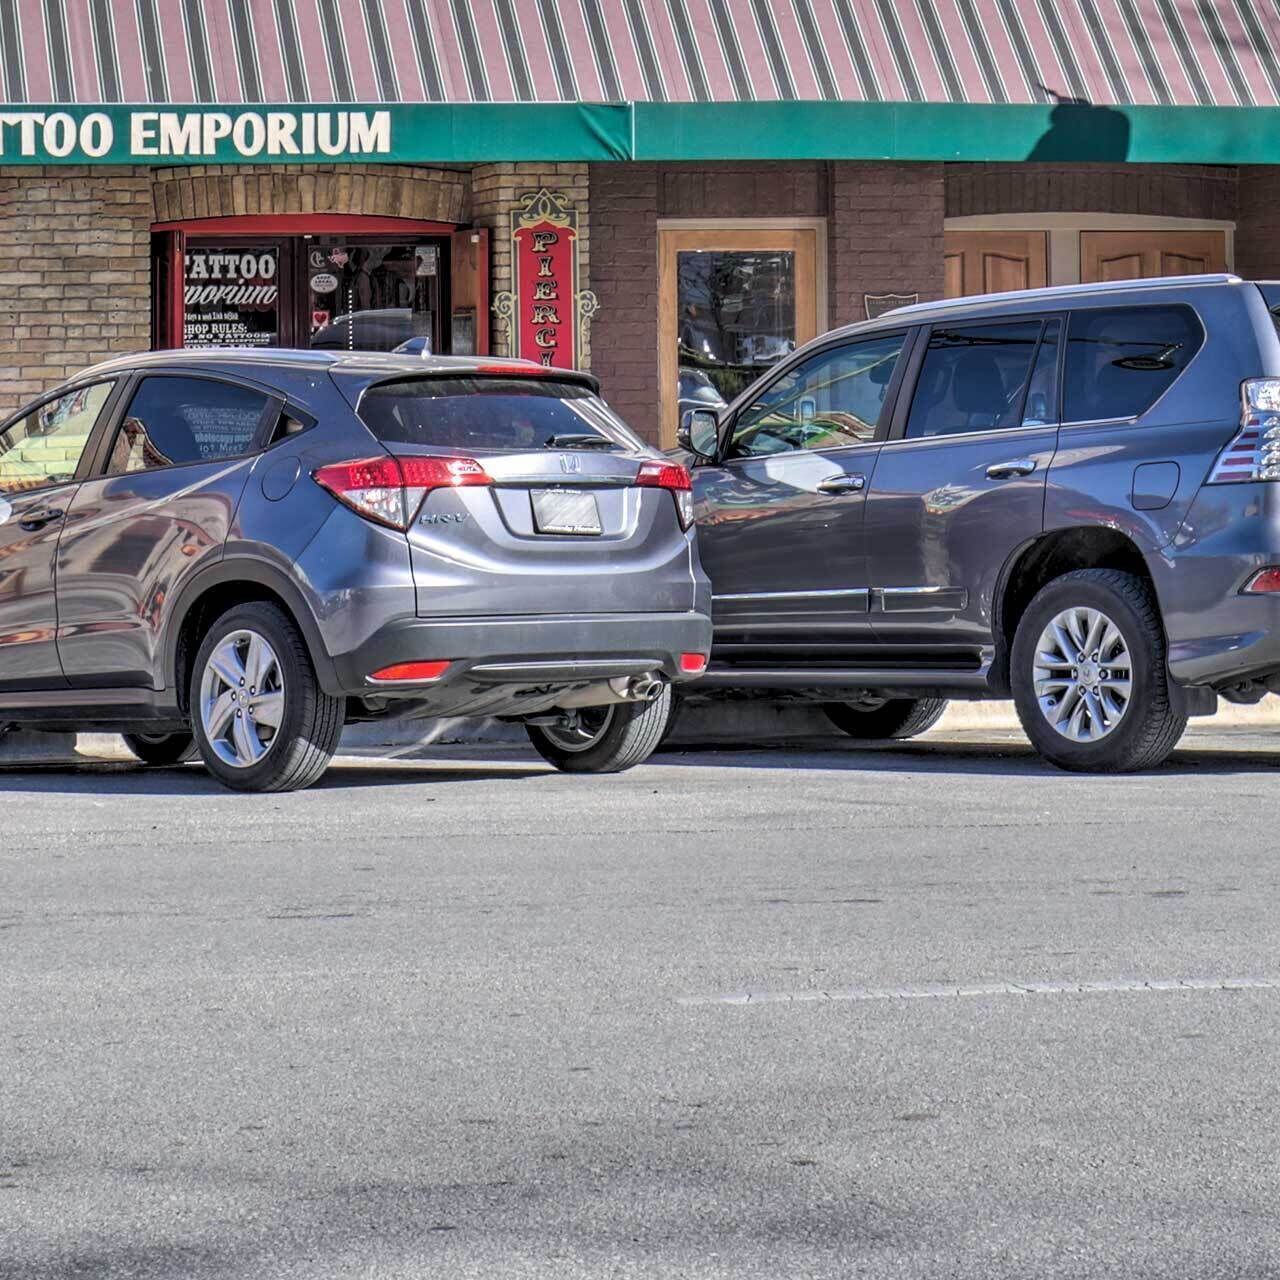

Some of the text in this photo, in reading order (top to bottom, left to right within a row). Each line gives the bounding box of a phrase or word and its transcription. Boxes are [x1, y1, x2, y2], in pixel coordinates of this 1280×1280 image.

[130, 110, 391, 157] EMPORIUM
[531, 231, 562, 368] PIERCI
[211, 322, 248, 334] RULES:
